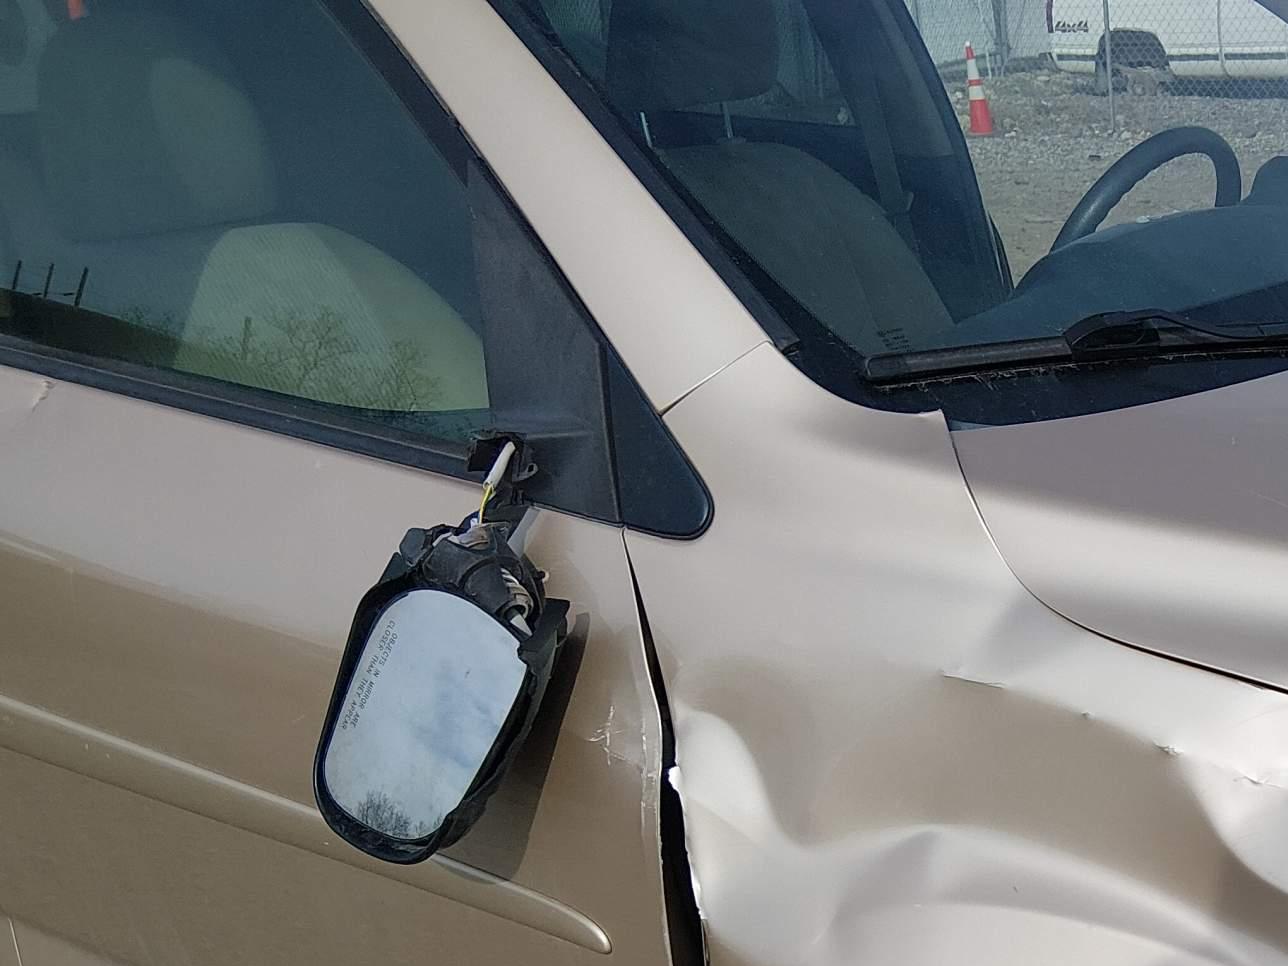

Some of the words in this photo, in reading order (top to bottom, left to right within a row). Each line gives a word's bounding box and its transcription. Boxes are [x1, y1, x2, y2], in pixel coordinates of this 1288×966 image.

[378, 620, 395, 651] CLOSER
[379, 632, 398, 666] OBJECTS
[366, 655, 379, 674] THAN
[357, 678, 368, 698] THEY
[359, 681, 375, 710] MIRROR
[342, 701, 357, 730] APPEAR
